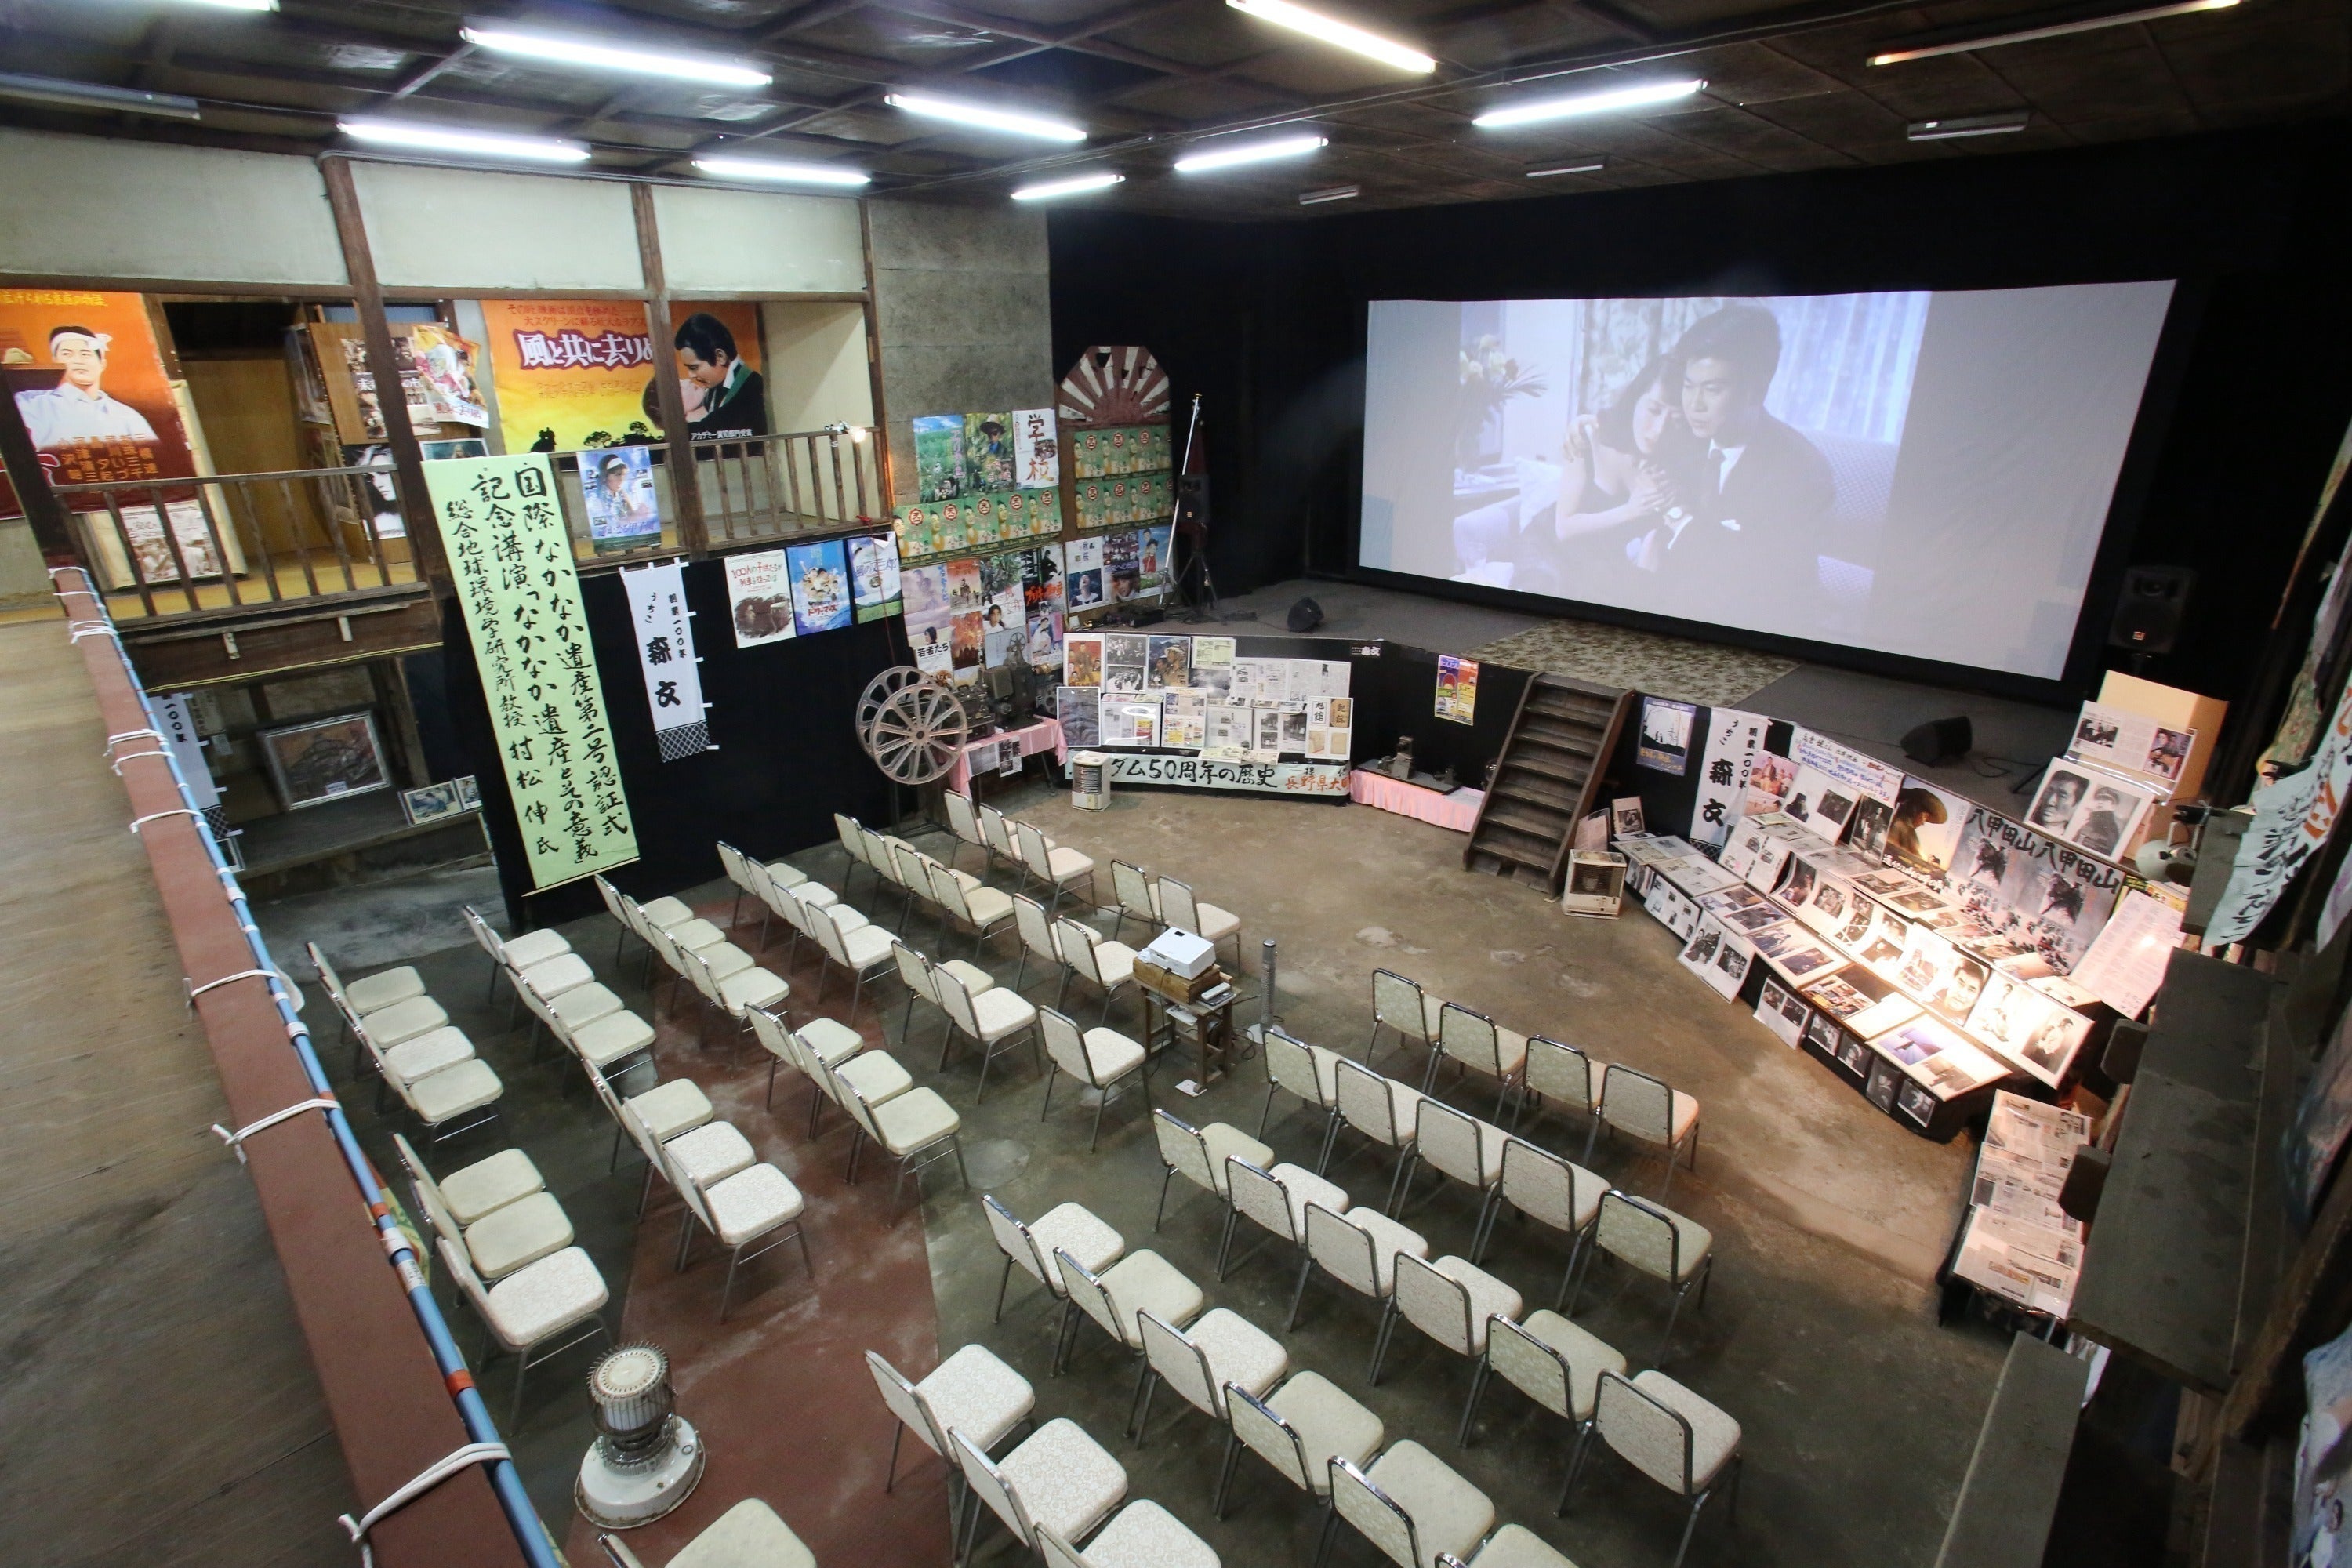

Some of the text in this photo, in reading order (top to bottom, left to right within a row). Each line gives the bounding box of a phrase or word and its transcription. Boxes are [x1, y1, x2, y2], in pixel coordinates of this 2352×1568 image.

[1026, 413, 1054, 482] 学校
[470, 470, 598, 864] 記念講演「なかなか遺産とその意義」
[514, 464, 628, 836] 国際なかなか遺産第二号認証式
[917, 642, 949, 658] 若者たち
[1966, 808, 2036, 857] 八甲田山
[2035, 841, 2121, 895] 八甲田山
